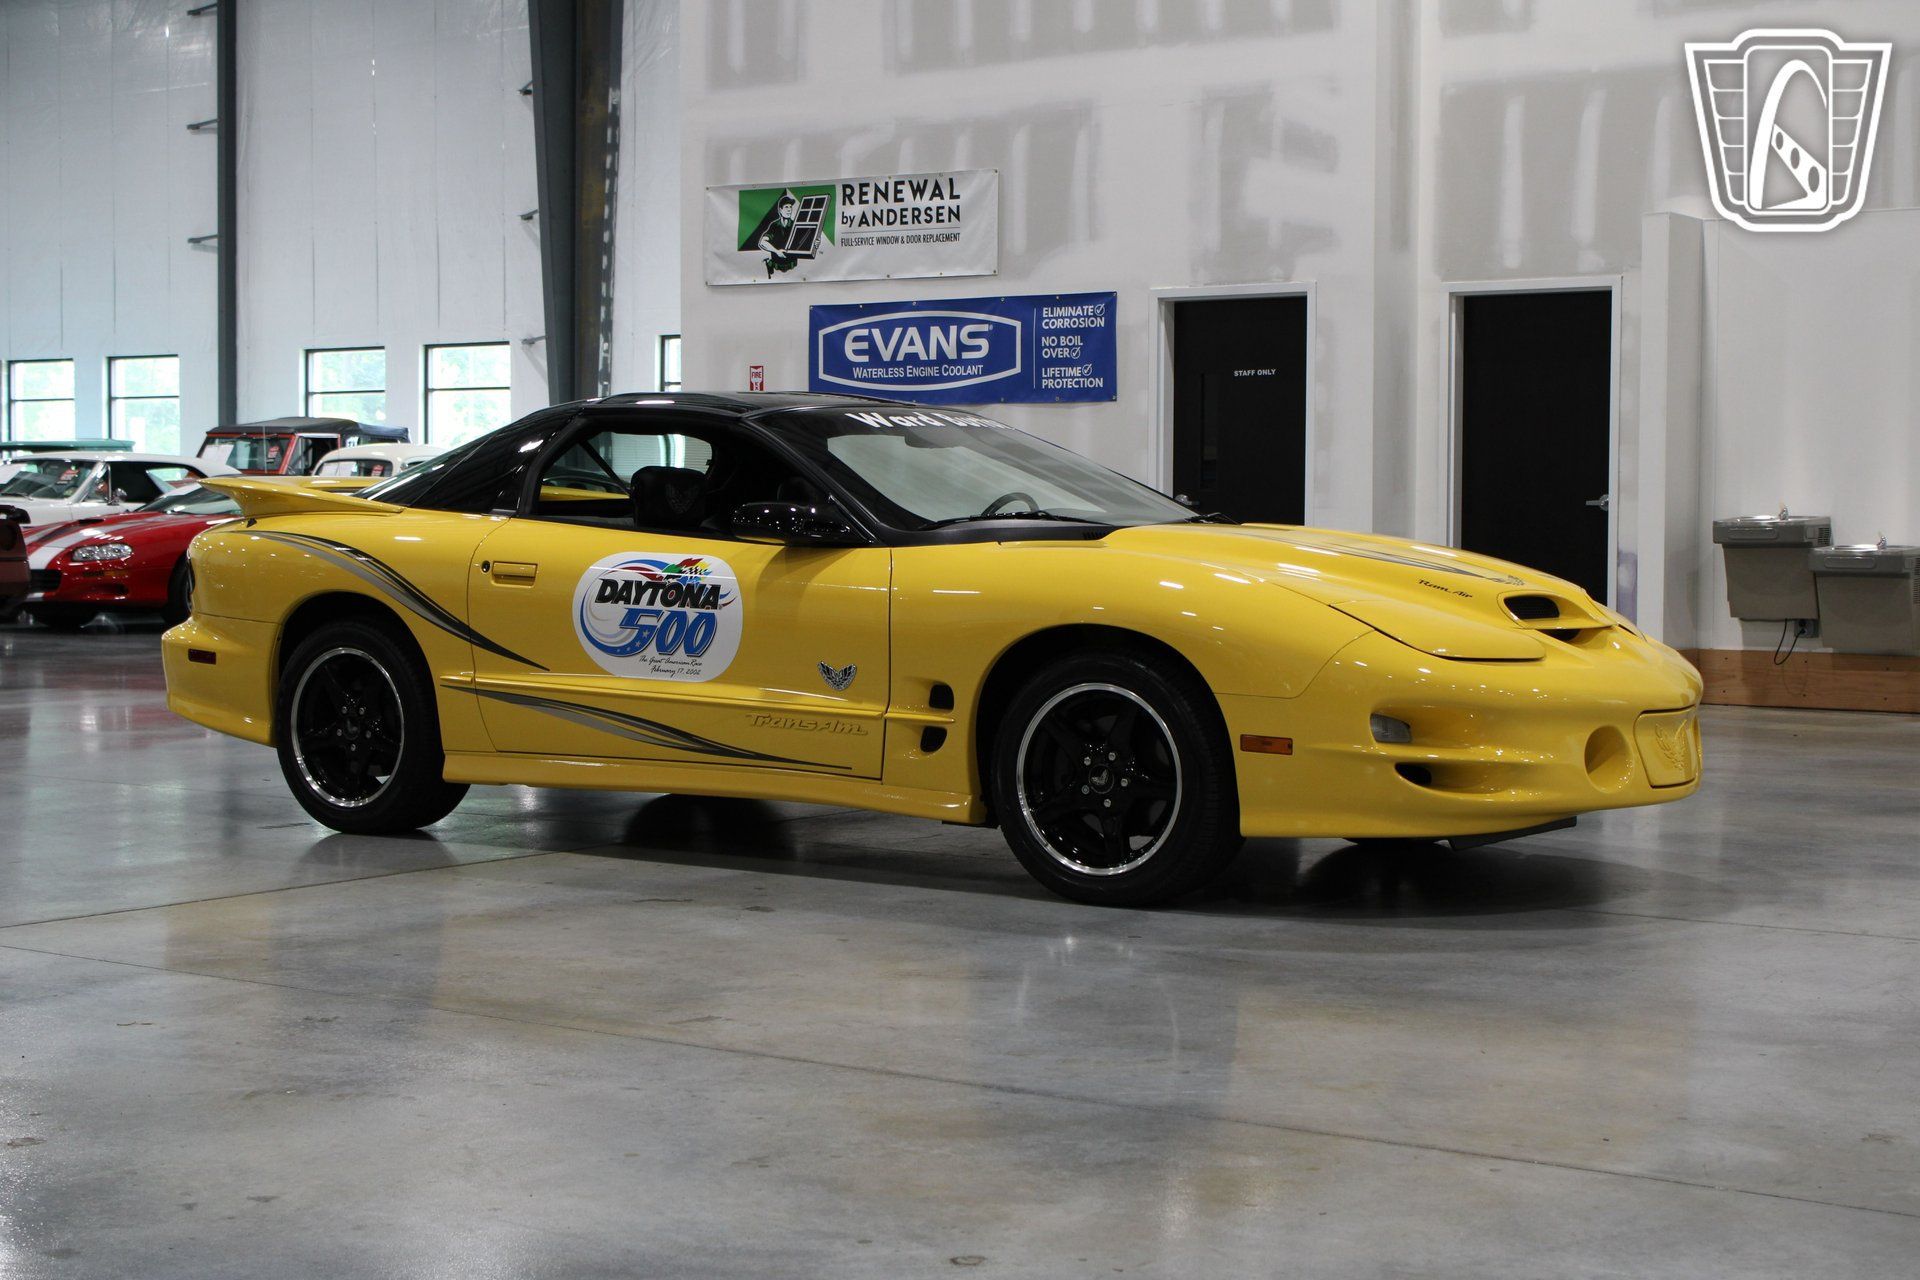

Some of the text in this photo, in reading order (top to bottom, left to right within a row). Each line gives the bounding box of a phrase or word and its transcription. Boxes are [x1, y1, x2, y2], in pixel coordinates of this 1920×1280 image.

[841, 177, 961, 206] RENEWAL
[841, 205, 961, 228] by ANDERSEN
[841, 232, 961, 247] FULL-SERVICE WINDOW & DOOR REPLACEMENT
[1042, 305, 1094, 318] ELIMINATE
[1042, 317, 1105, 330] CORROSION
[844, 323, 990, 363] EVANS
[1041, 335, 1083, 347] NO BOIL
[1042, 347, 1070, 359] OVER
[853, 364, 984, 379] WATERLESS ENGINE COOLANT
[1042, 366, 1082, 378] LIFETIME
[1257, 368, 1277, 376] ONLY
[1042, 377, 1104, 389] PROTECTION
[845, 411, 946, 427] Ward
[594, 577, 722, 610] DAYTONA
[592, 607, 718, 658] 500
[649, 656, 665, 666] Great
[650, 665, 676, 678] February
